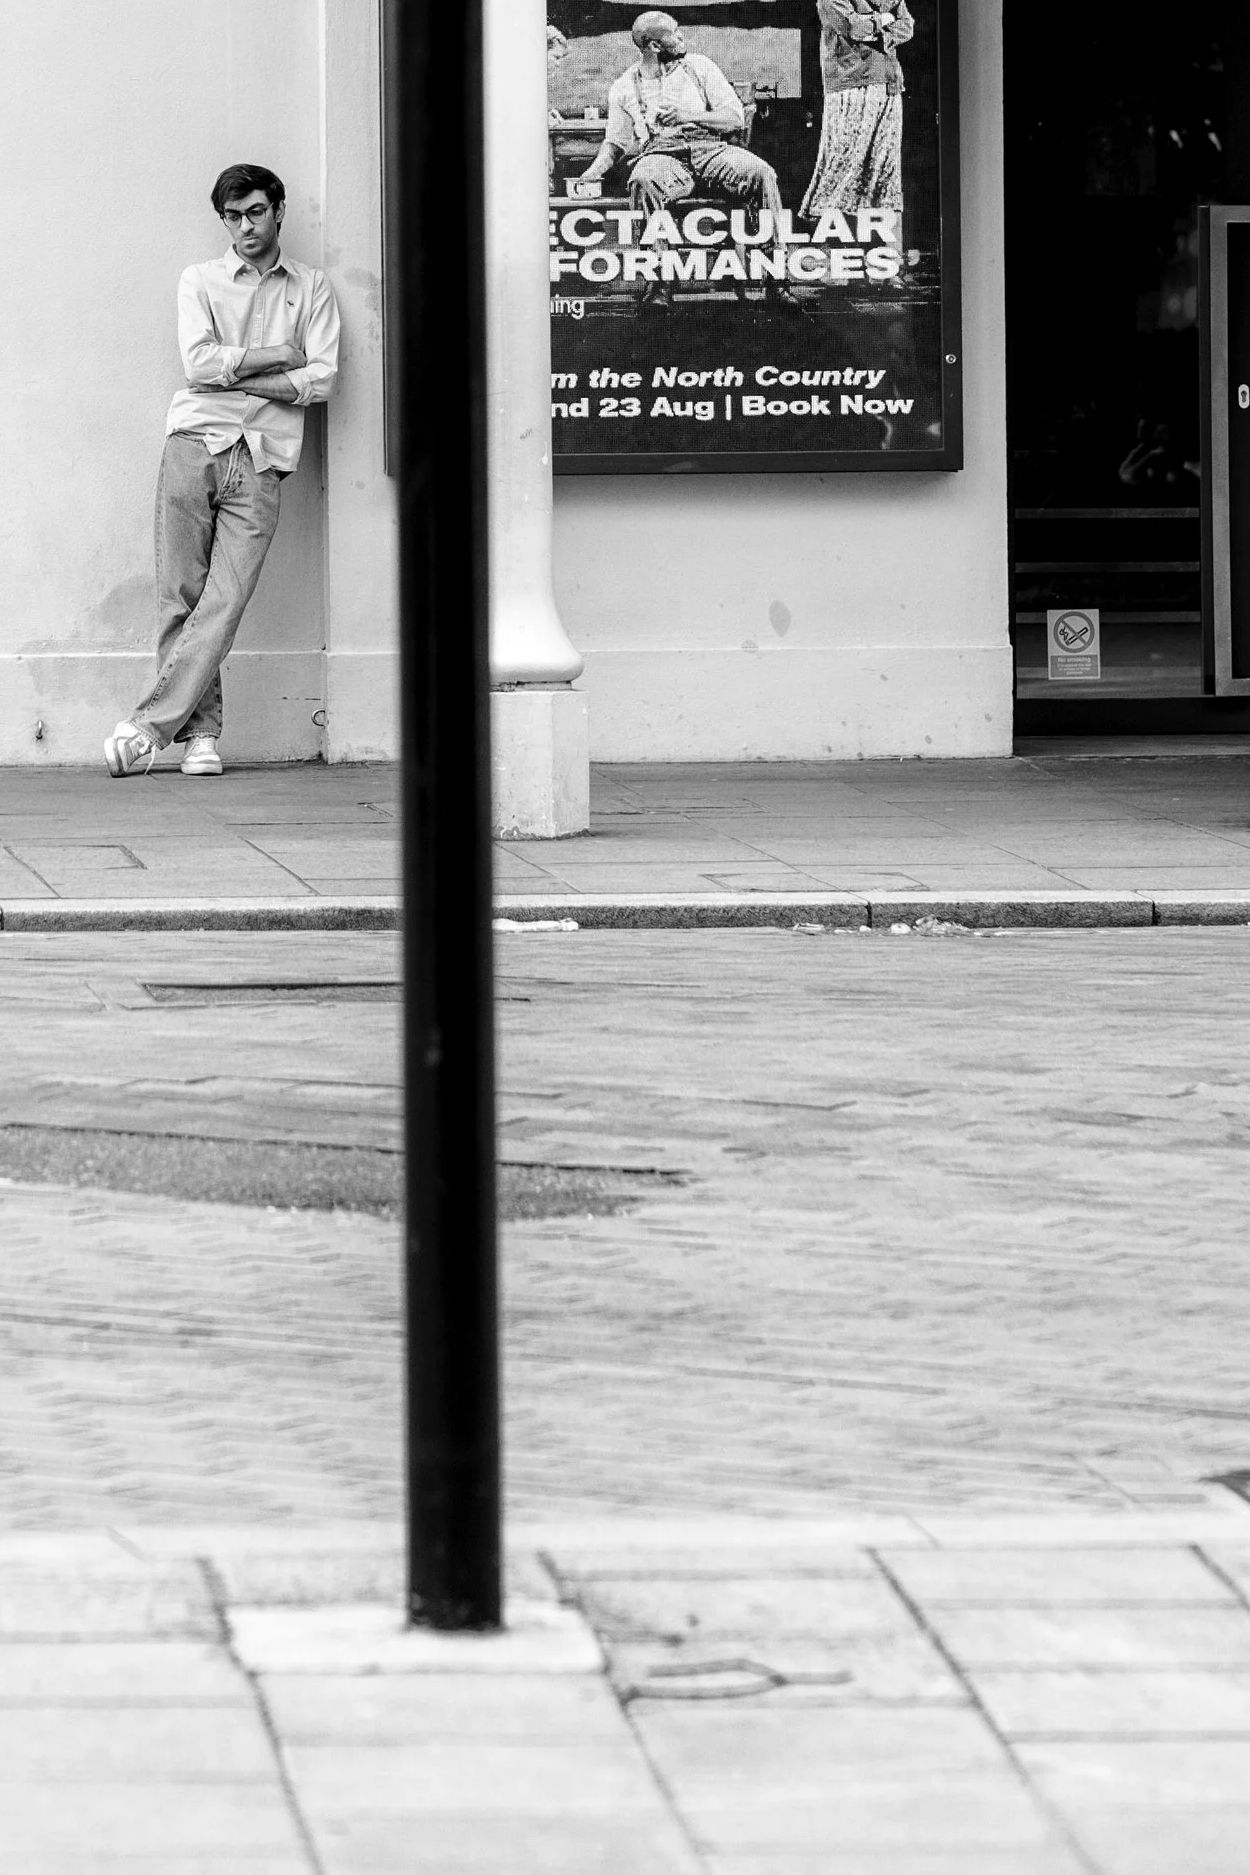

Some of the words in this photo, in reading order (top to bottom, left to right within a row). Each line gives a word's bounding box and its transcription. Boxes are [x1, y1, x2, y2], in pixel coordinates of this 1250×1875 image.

[588, 366, 643, 389] the
[652, 365, 744, 389] North
[754, 364, 887, 389] Country
[598, 396, 642, 418] 23
[650, 396, 715, 421] Aug
[741, 395, 831, 417] Book
[840, 394, 915, 416] Now
